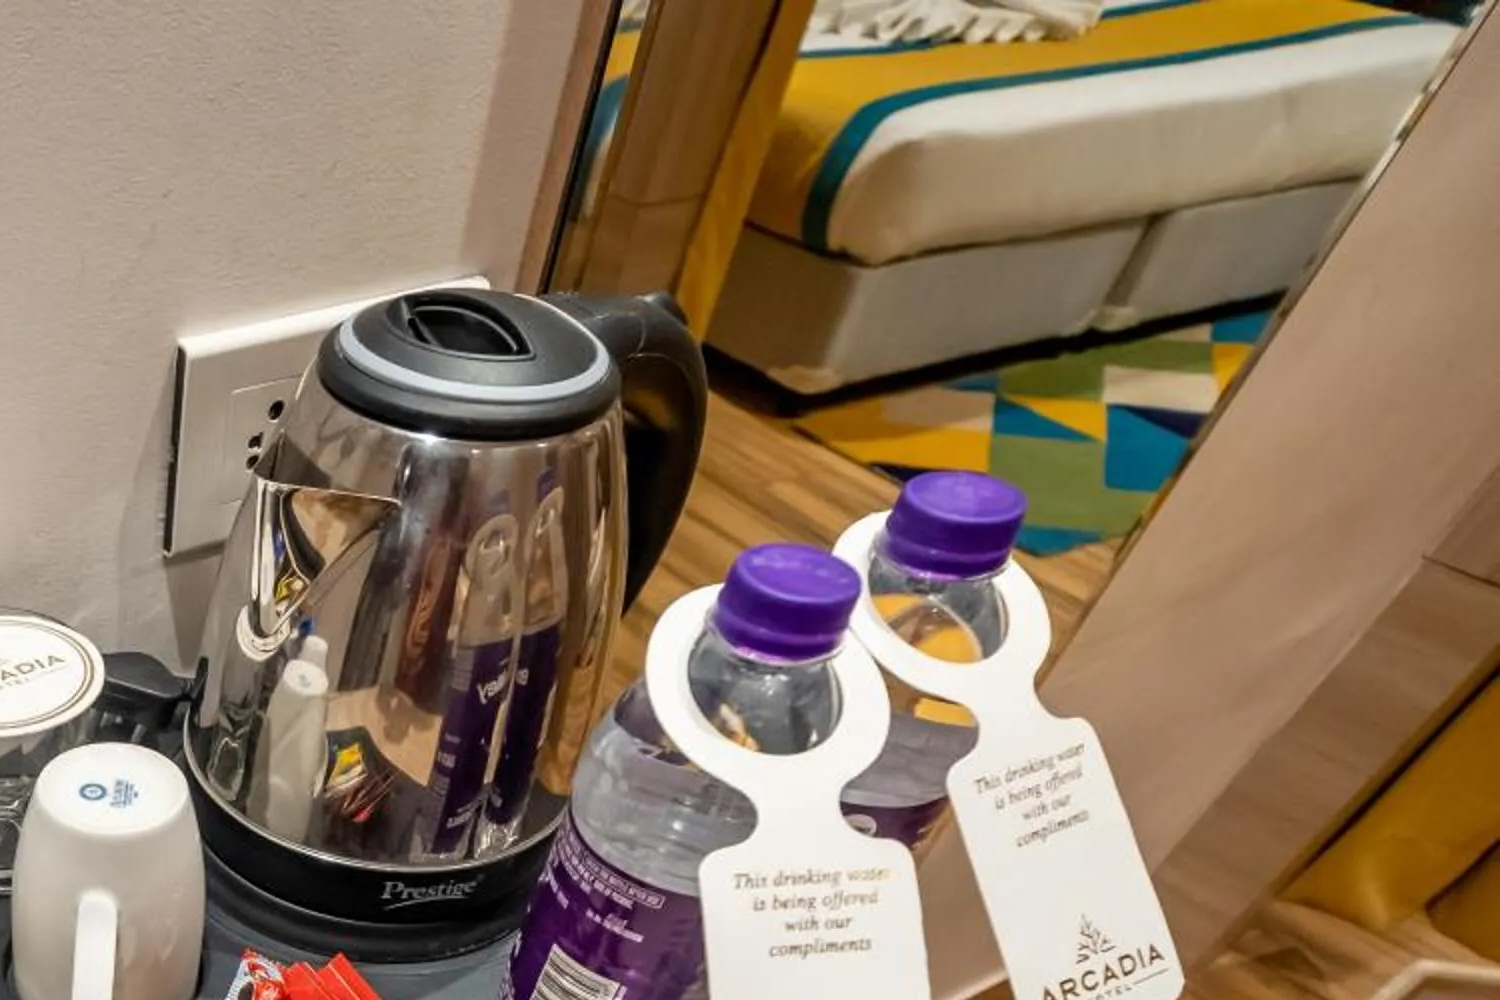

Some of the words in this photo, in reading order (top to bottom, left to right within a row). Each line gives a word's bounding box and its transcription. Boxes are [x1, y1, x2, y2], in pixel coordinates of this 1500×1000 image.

[380, 879, 478, 900] Prestige
[733, 872, 767, 890] This
[773, 869, 842, 887] drinking
[753, 896, 766, 912] is
[772, 894, 817, 912] being
[822, 889, 879, 911] offered
[785, 916, 819, 931] with
[824, 917, 853, 930] our
[768, 938, 873, 960] compliments
